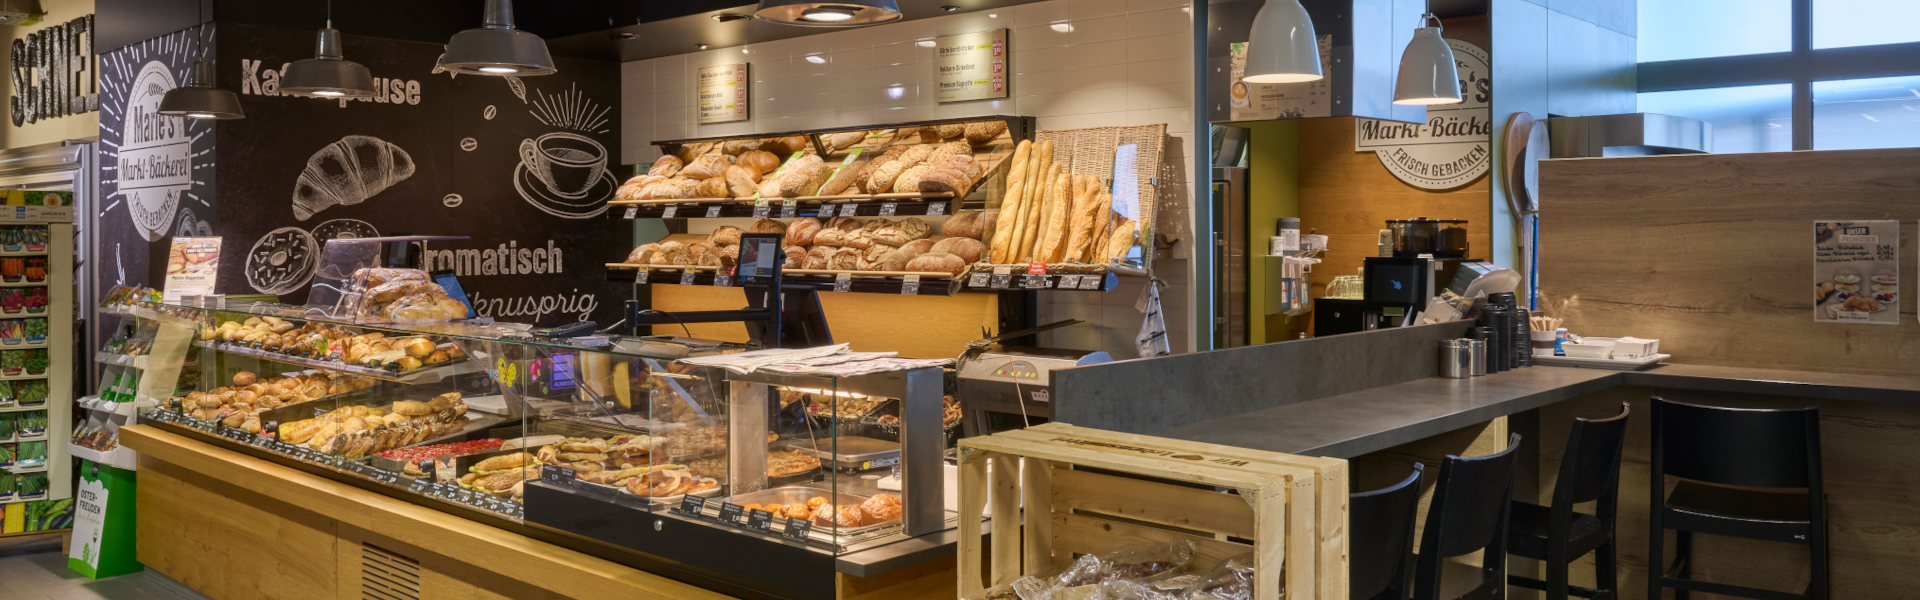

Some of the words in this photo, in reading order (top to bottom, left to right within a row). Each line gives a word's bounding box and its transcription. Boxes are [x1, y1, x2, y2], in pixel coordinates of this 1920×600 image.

[134, 102, 174, 143] Maries
[120, 152, 188, 182] Markt-Bäckerei
[1393, 148, 1429, 176] FRISCH
[1432, 144, 1486, 177] GEBACKEN
[134, 191, 149, 225] FRISCH
[150, 189, 173, 226] GEBACKEN
[411, 240, 562, 276] romatisch
[474, 292, 598, 322] knusprig
[79, 500, 101, 515] FREUDEN
[80, 489, 98, 502] OSTER-
